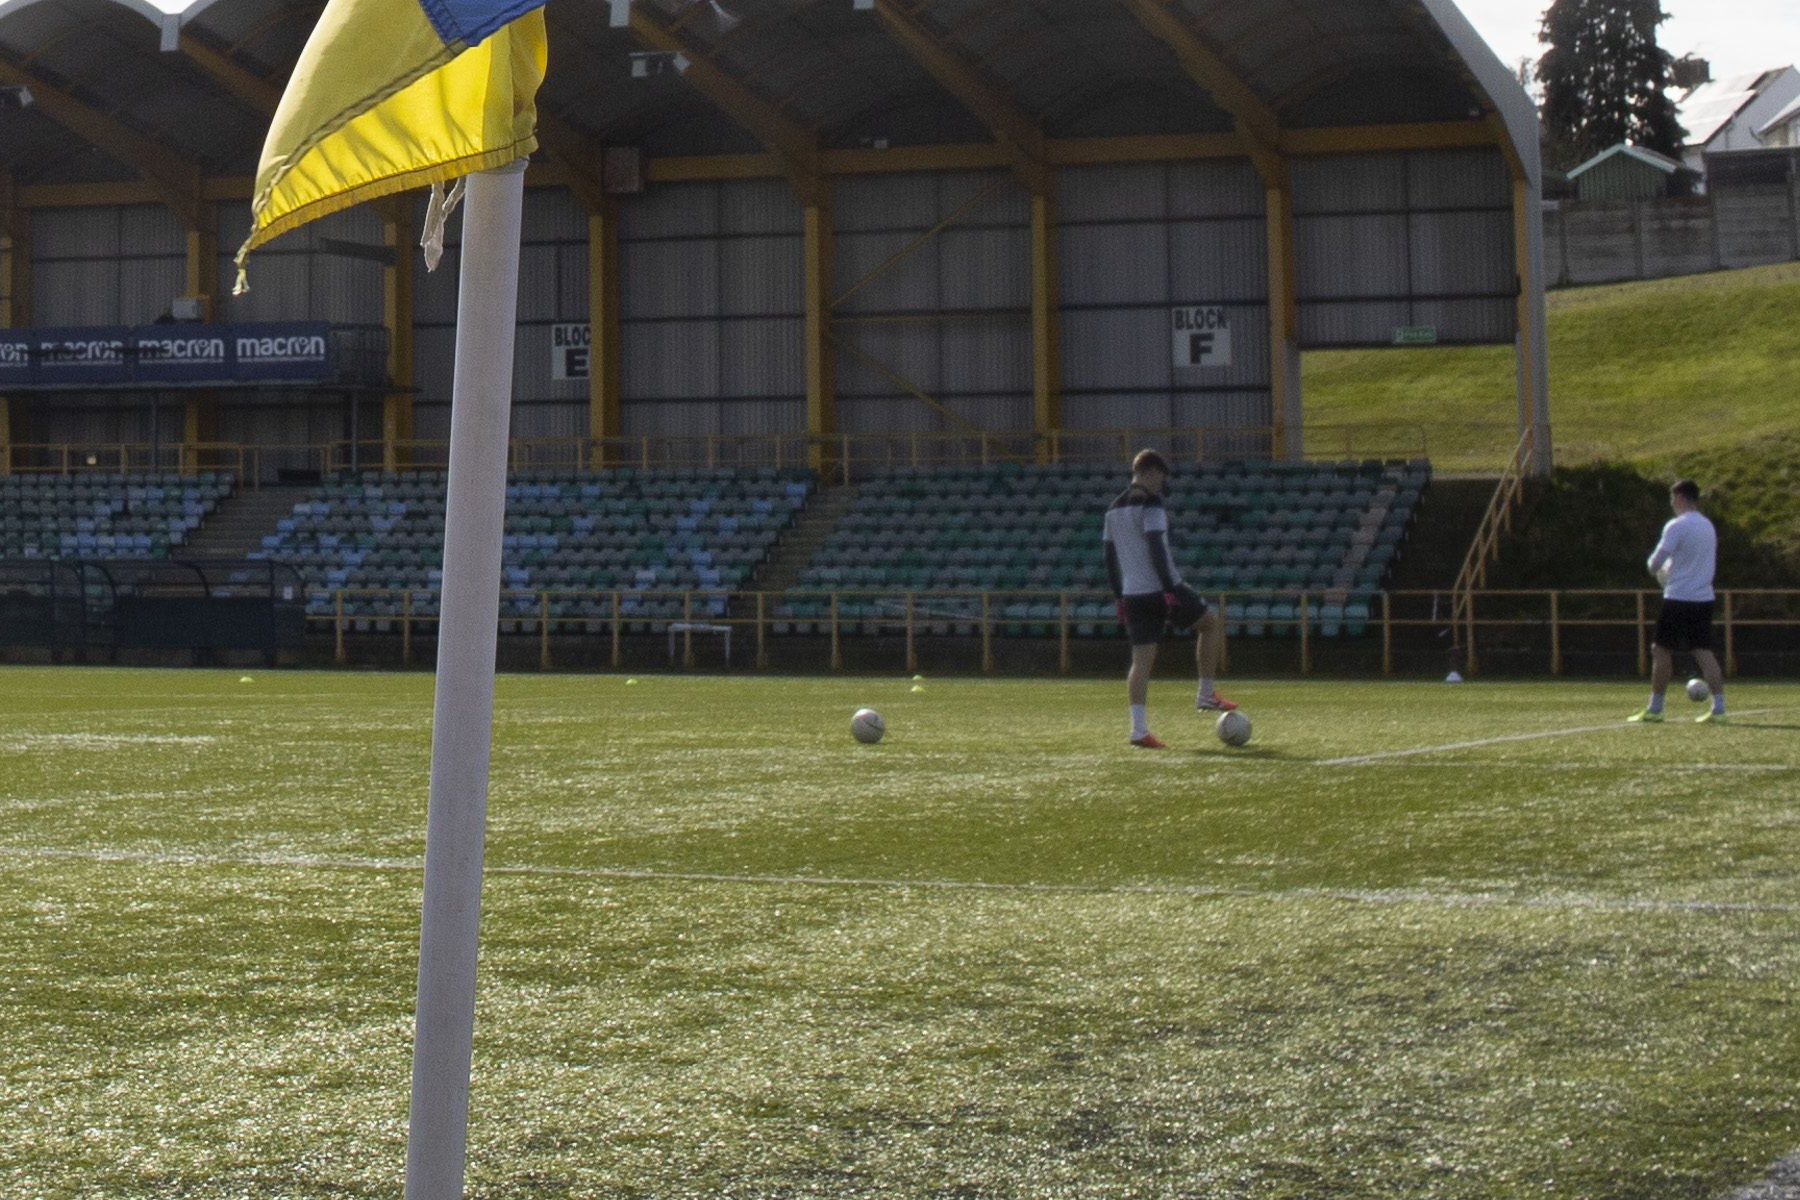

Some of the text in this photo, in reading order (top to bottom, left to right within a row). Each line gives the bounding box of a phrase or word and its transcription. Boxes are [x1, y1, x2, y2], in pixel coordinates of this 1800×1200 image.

[1174, 308, 1227, 329] BLOCK
[237, 336, 325, 356] macron
[554, 326, 591, 347] BLOC
[1190, 333, 1215, 364] F
[566, 349, 588, 377] E
